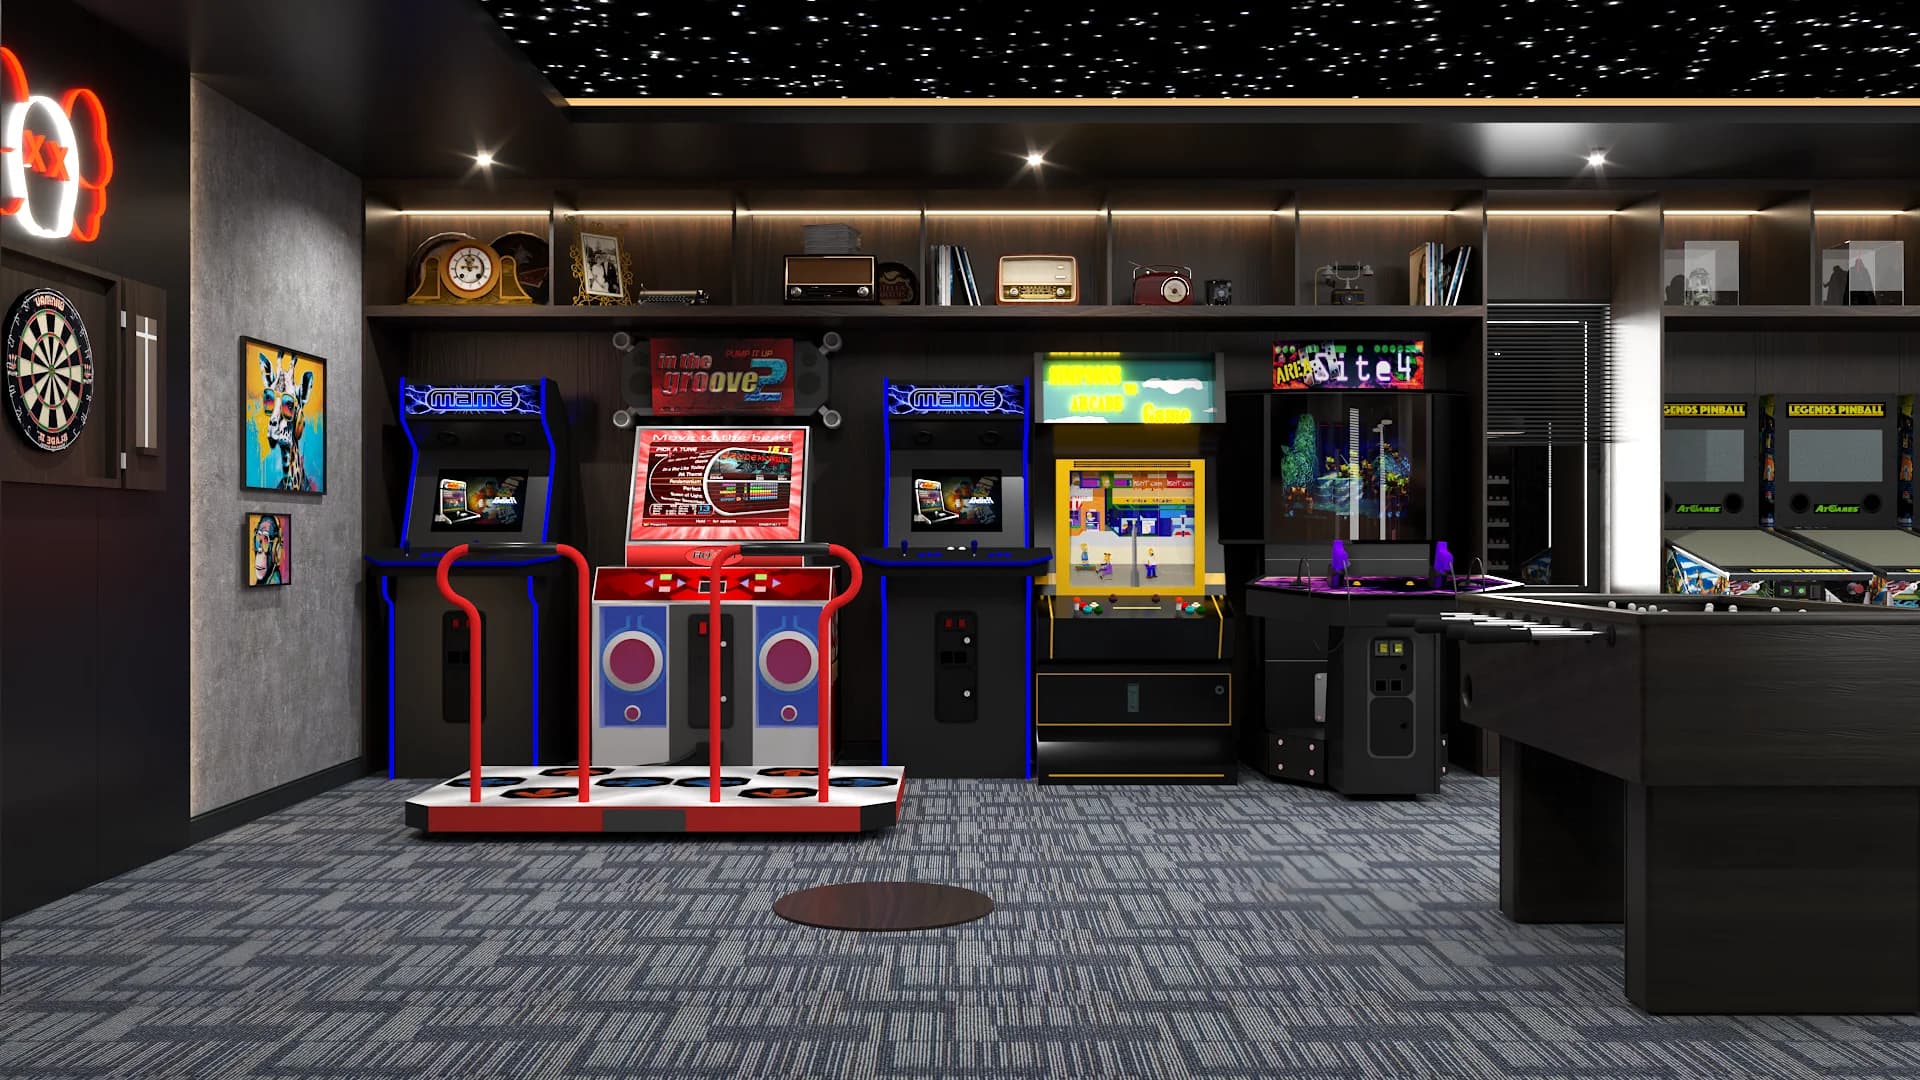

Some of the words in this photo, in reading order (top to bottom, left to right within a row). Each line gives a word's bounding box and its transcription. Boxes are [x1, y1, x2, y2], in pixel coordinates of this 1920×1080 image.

[658, 353, 677, 369] in
[680, 353, 713, 369] the
[1276, 358, 1313, 384] AREA
[661, 371, 759, 397] groove
[744, 358, 788, 401] 2
[1142, 402, 1191, 423] Game
[1700, 405, 1745, 415] PINBALL
[1789, 405, 1836, 415] LEGENDS
[1838, 405, 1884, 415] PINBALL
[652, 434, 696, 442] Move
